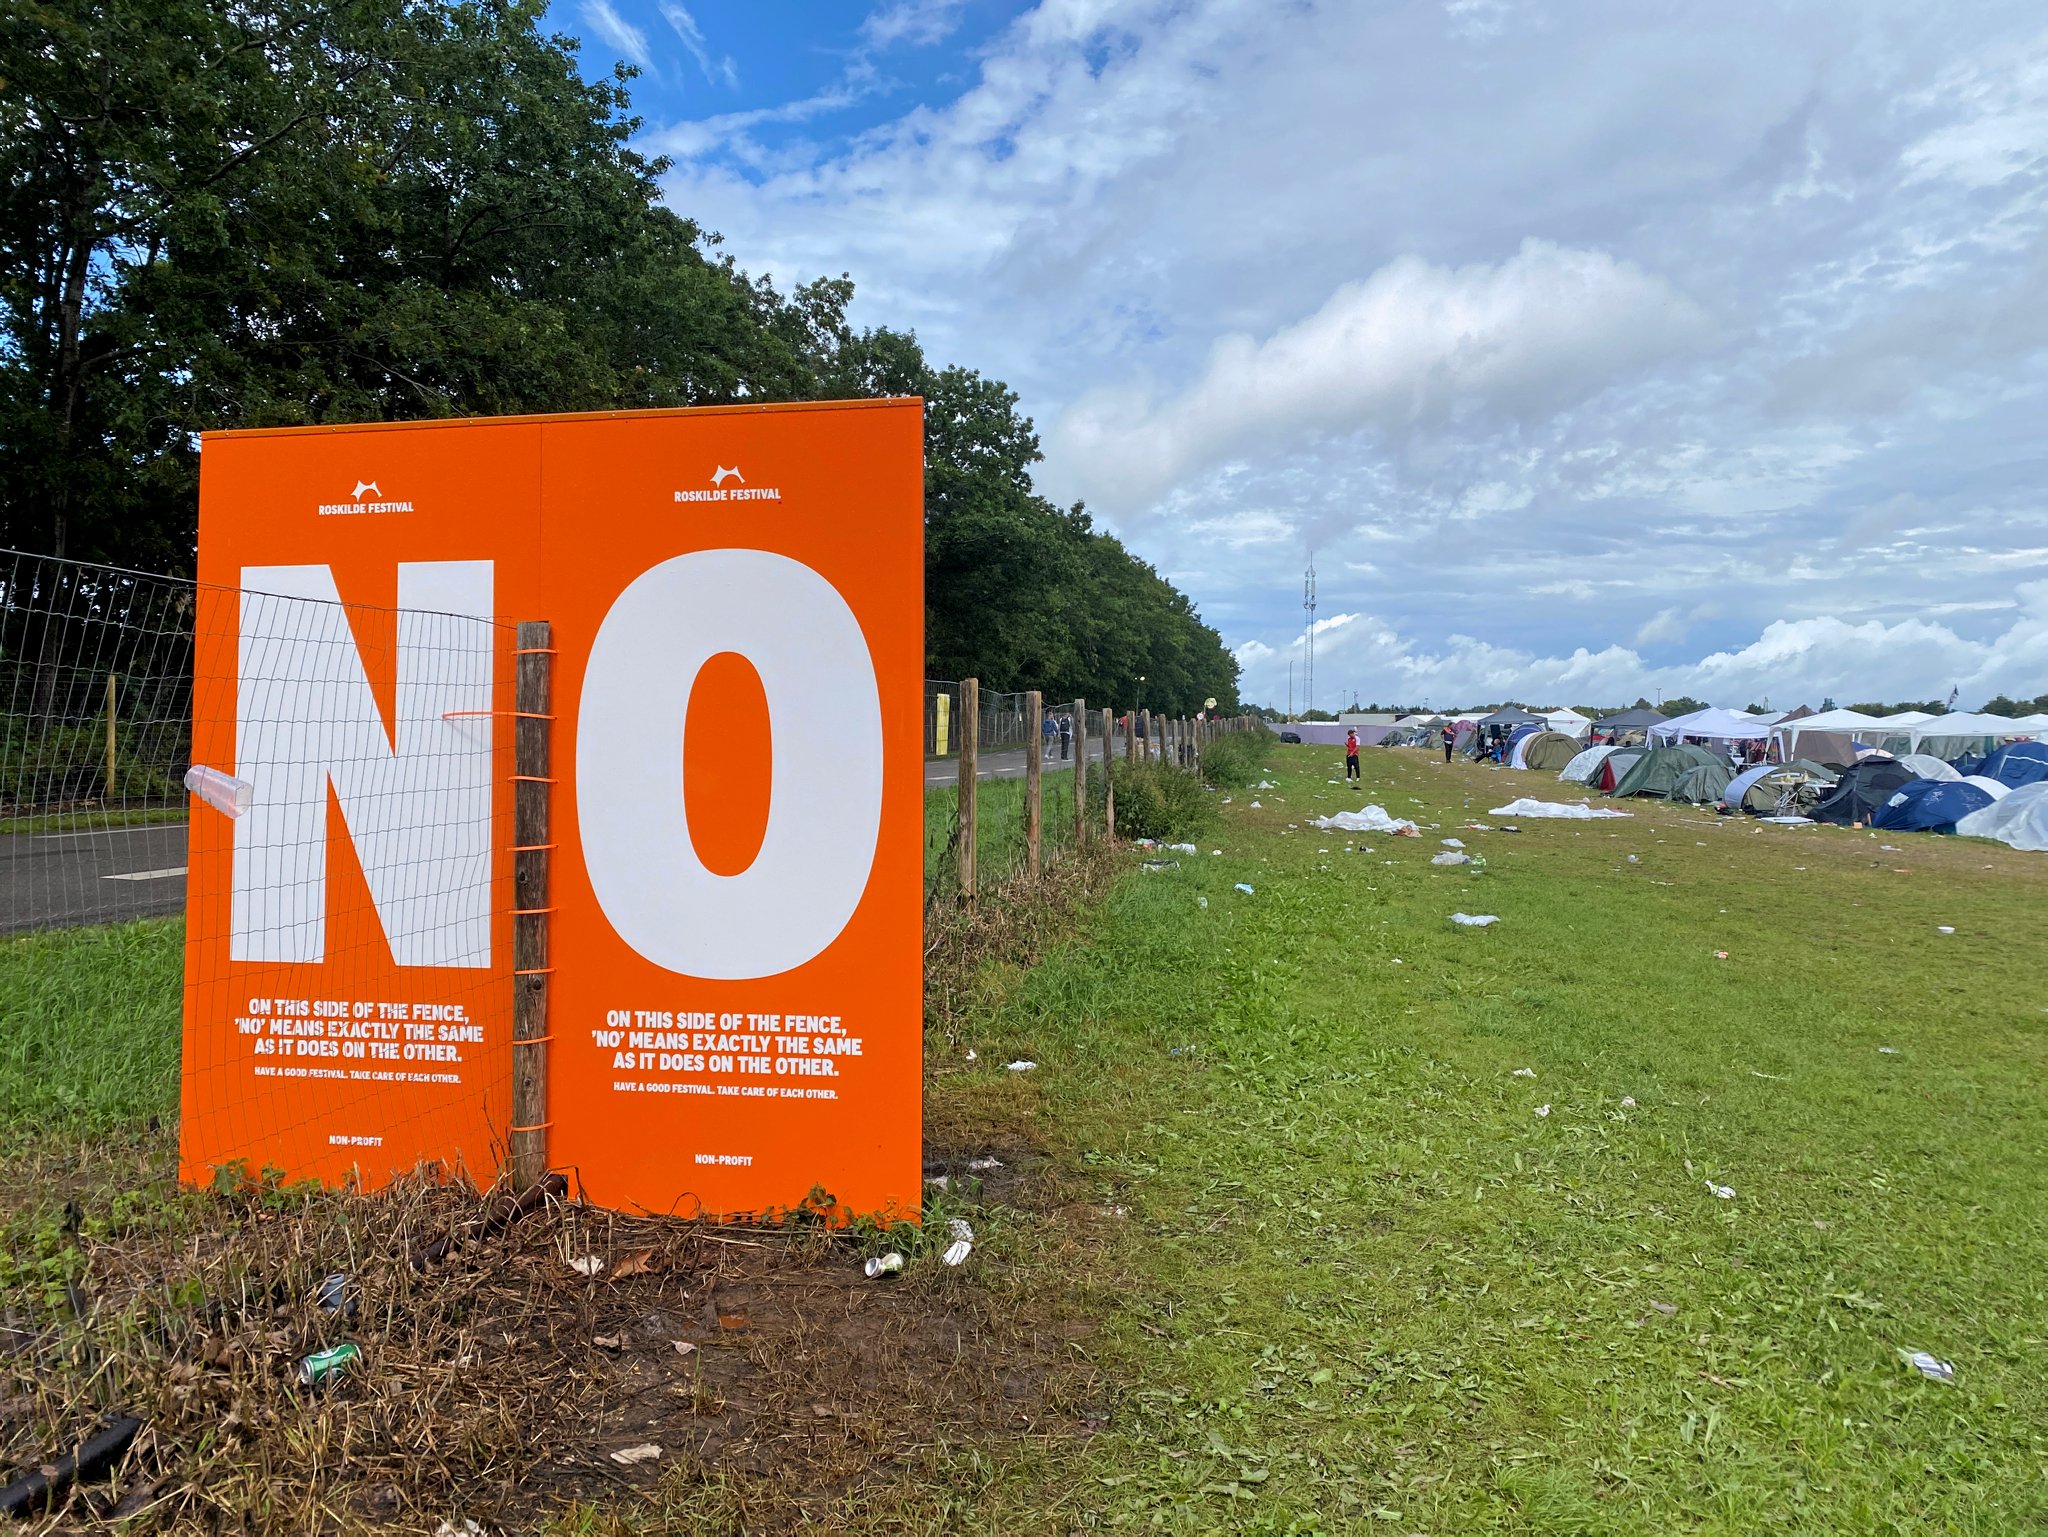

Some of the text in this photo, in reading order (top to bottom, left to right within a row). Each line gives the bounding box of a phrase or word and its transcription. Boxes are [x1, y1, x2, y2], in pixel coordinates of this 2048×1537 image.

[674, 488, 781, 502] ROSKILDE FESTIVAL
[319, 502, 414, 515] ROSKILDE FESTIVAL
[249, 998, 469, 1025] ON THIS SIDE OF THE FENCE,
[269, 1019, 324, 1036] MEANS
[328, 1021, 400, 1039] EXACTLY
[403, 1024, 434, 1040] THE
[438, 1025, 484, 1042] SAME
[607, 1010, 847, 1037] ON THIS SIDE OF THE FENCE,
[254, 1038, 462, 1062] AS IT DOES ON THE OTHER.
[629, 1031, 689, 1050] MEANS
[693, 1034, 770, 1052] EXACTLY
[775, 1036, 809, 1054] THE
[813, 1037, 862, 1055] SAME
[613, 1052, 839, 1076] AS IT DOES ON THE OTHER.
[255, 1067, 461, 1083] HAVE A GOOD FESTIVAL. TAKE CARE OF EACH OTHER.
[614, 1082, 838, 1099] HAVE A GOOD FESTIVAL. TAKE CARE OF EACH OTHER.
[329, 1135, 382, 1146] NON-PROFIT
[695, 1154, 752, 1166] NON-PROFIT
